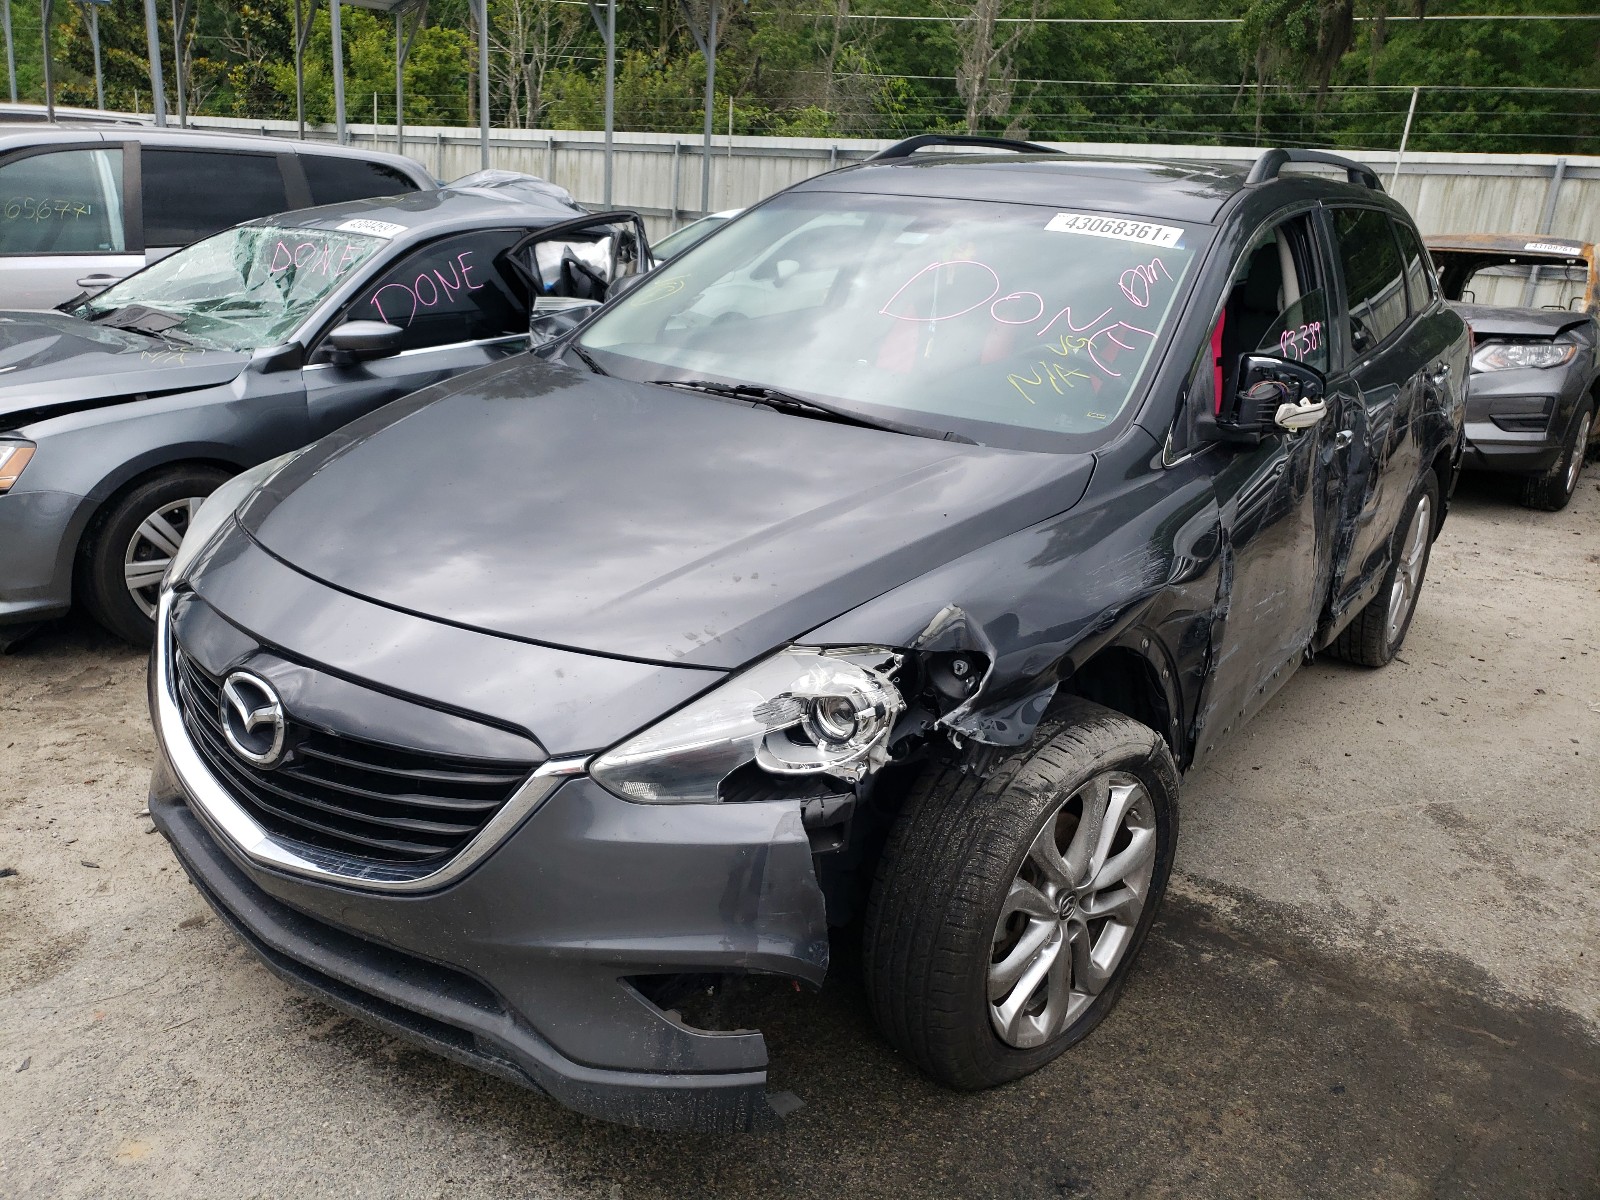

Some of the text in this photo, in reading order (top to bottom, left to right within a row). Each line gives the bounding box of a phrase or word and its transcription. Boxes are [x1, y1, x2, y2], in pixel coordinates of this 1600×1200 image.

[1065, 216, 1163, 241] 43068361
[271, 241, 365, 276] DONE
[370, 251, 484, 327] DONE
[879, 260, 1158, 376] DONE
